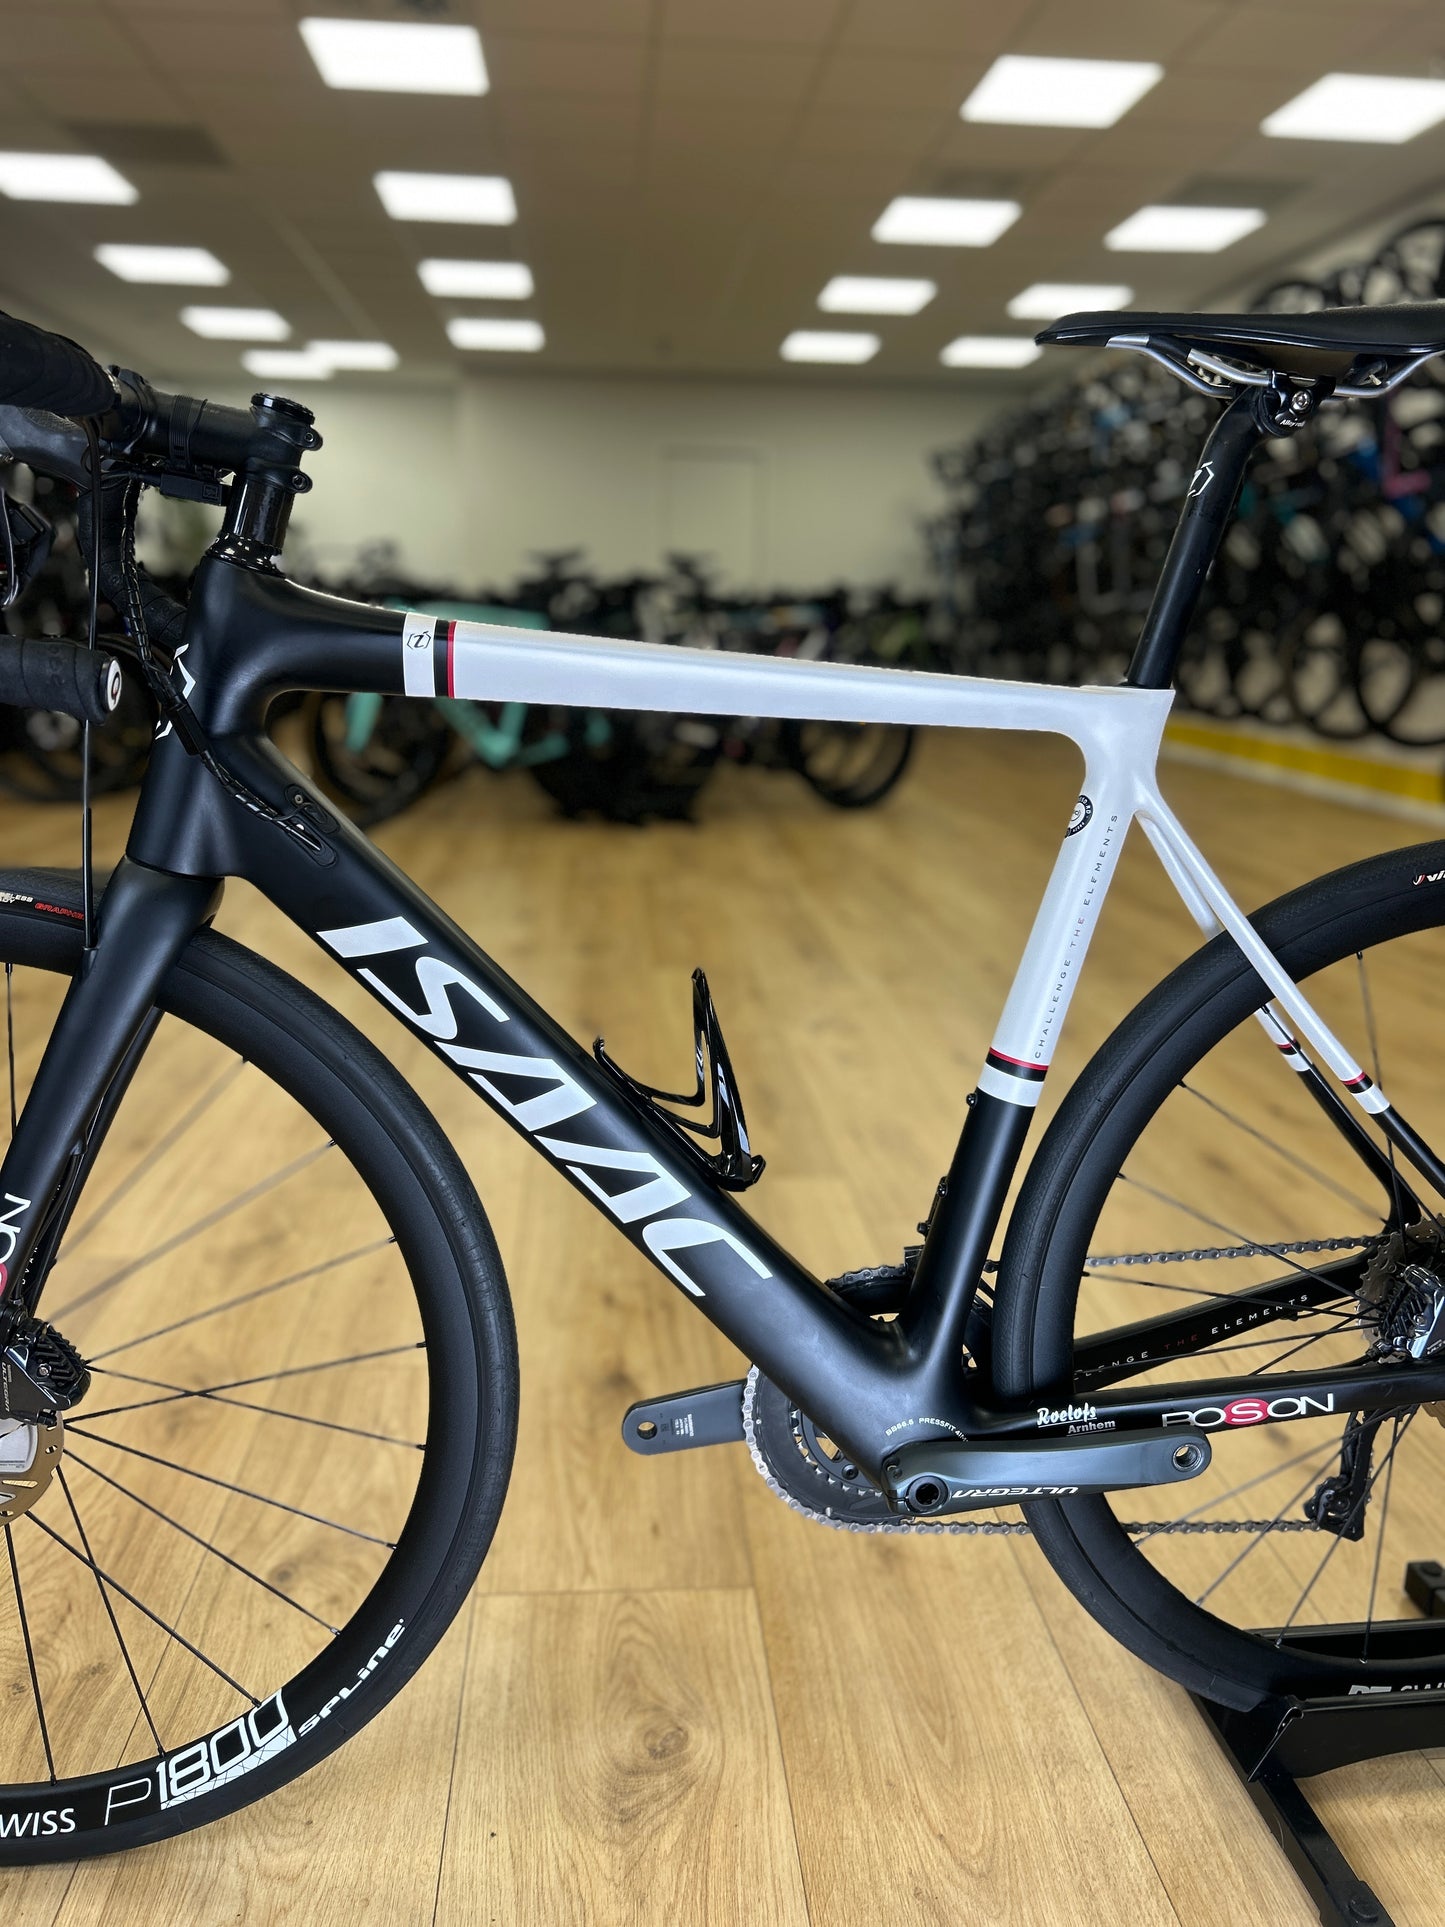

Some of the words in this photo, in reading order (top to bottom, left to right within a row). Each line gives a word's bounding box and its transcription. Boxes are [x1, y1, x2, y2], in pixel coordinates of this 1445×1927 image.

[1034, 959, 1072, 1059] CHALLENGE
[1069, 917, 1086, 948] THE
[1083, 815, 1118, 906] ELEMENTS
[316, 916, 774, 1297] ISAAC
[1164, 1334, 1199, 1350] THE
[1211, 1294, 1308, 1335] ELEMENTS
[918, 1417, 957, 1432] PRESSFIT
[1036, 1401, 1098, 1426] Roelofs
[1067, 1420, 1116, 1434] Arnhem
[951, 1486, 1079, 1499] ULTEGRA
